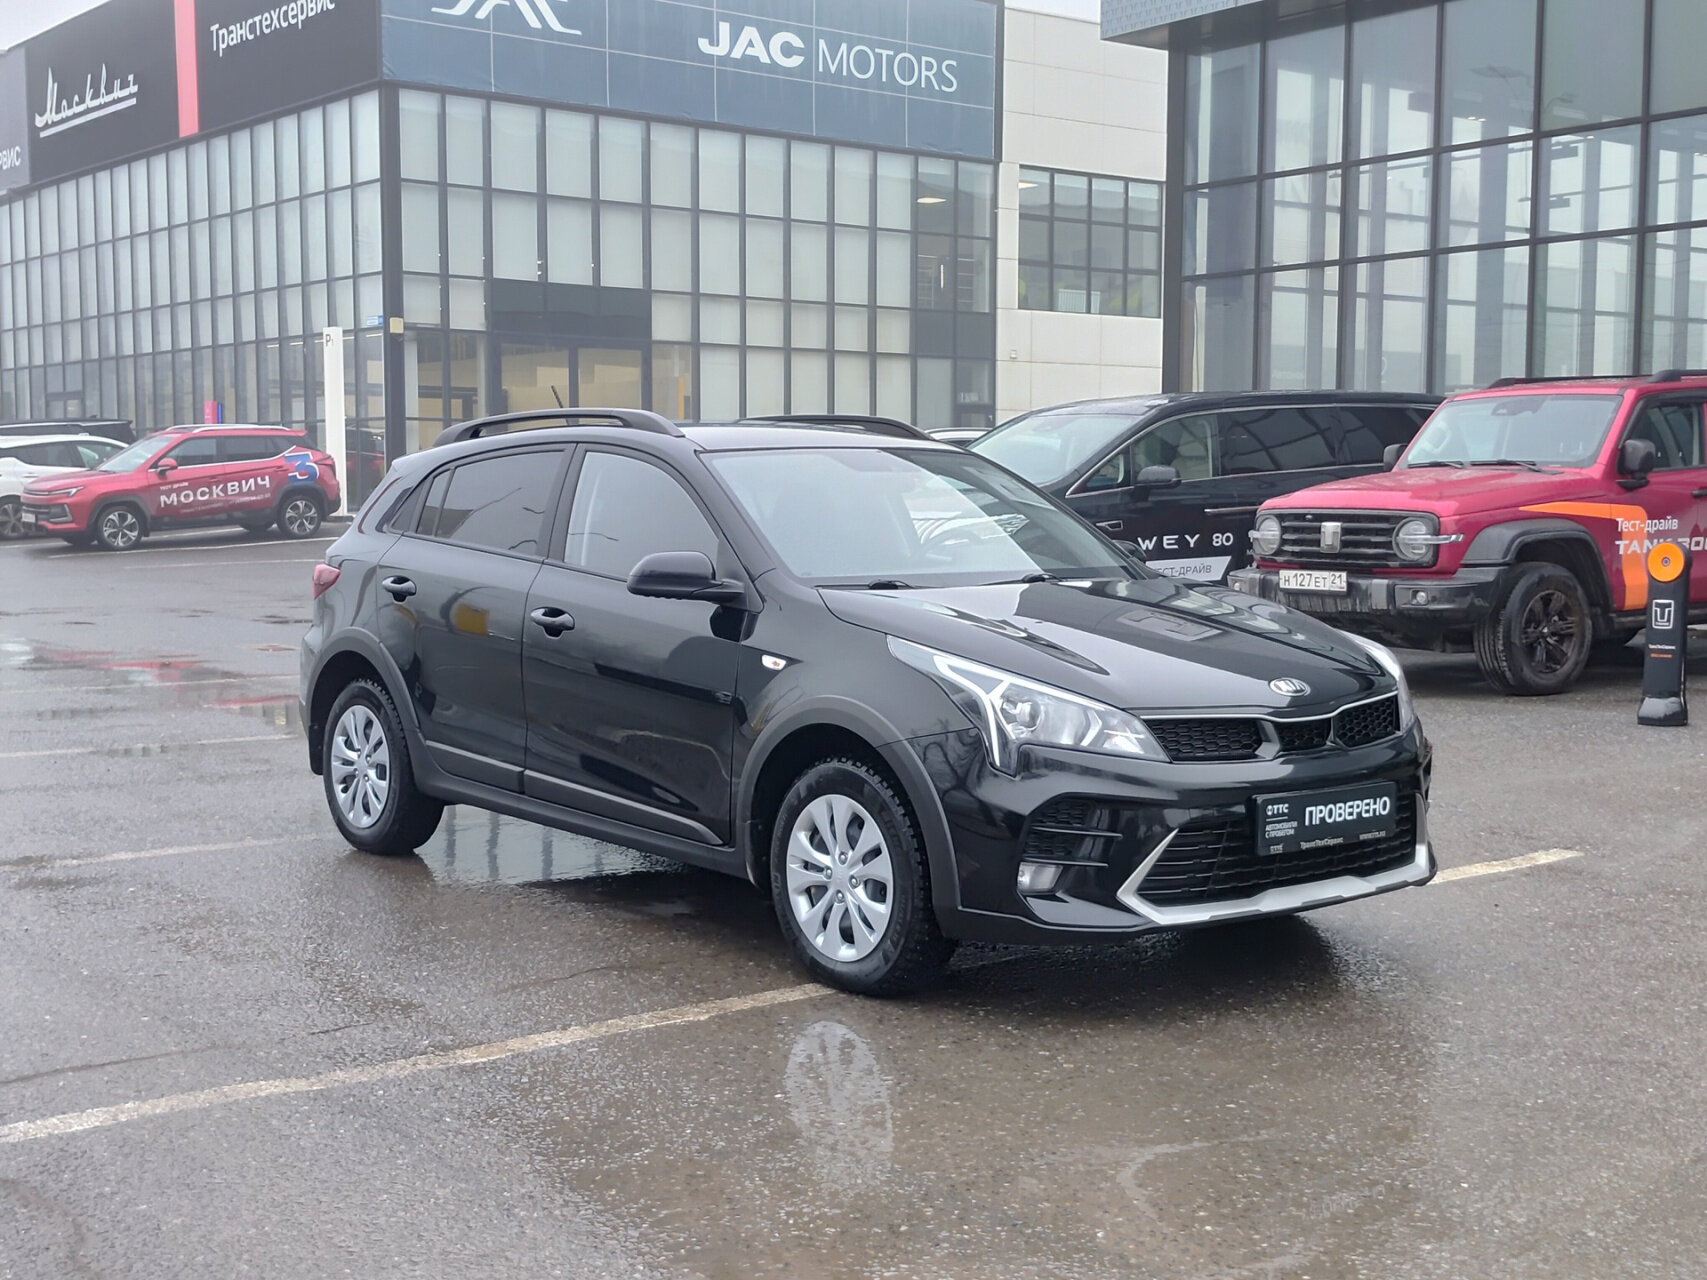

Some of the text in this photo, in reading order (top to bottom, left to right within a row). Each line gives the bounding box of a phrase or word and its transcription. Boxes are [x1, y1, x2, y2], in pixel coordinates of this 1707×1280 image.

[697, 21, 958, 92] JAC MOTORS
[160, 475, 271, 508] МОСКВИЧ
[1616, 515, 1678, 534] Тест-драйв
[1137, 532, 1234, 551] WEY 80
[1304, 796, 1391, 827] ПРОВЕРЕНО
